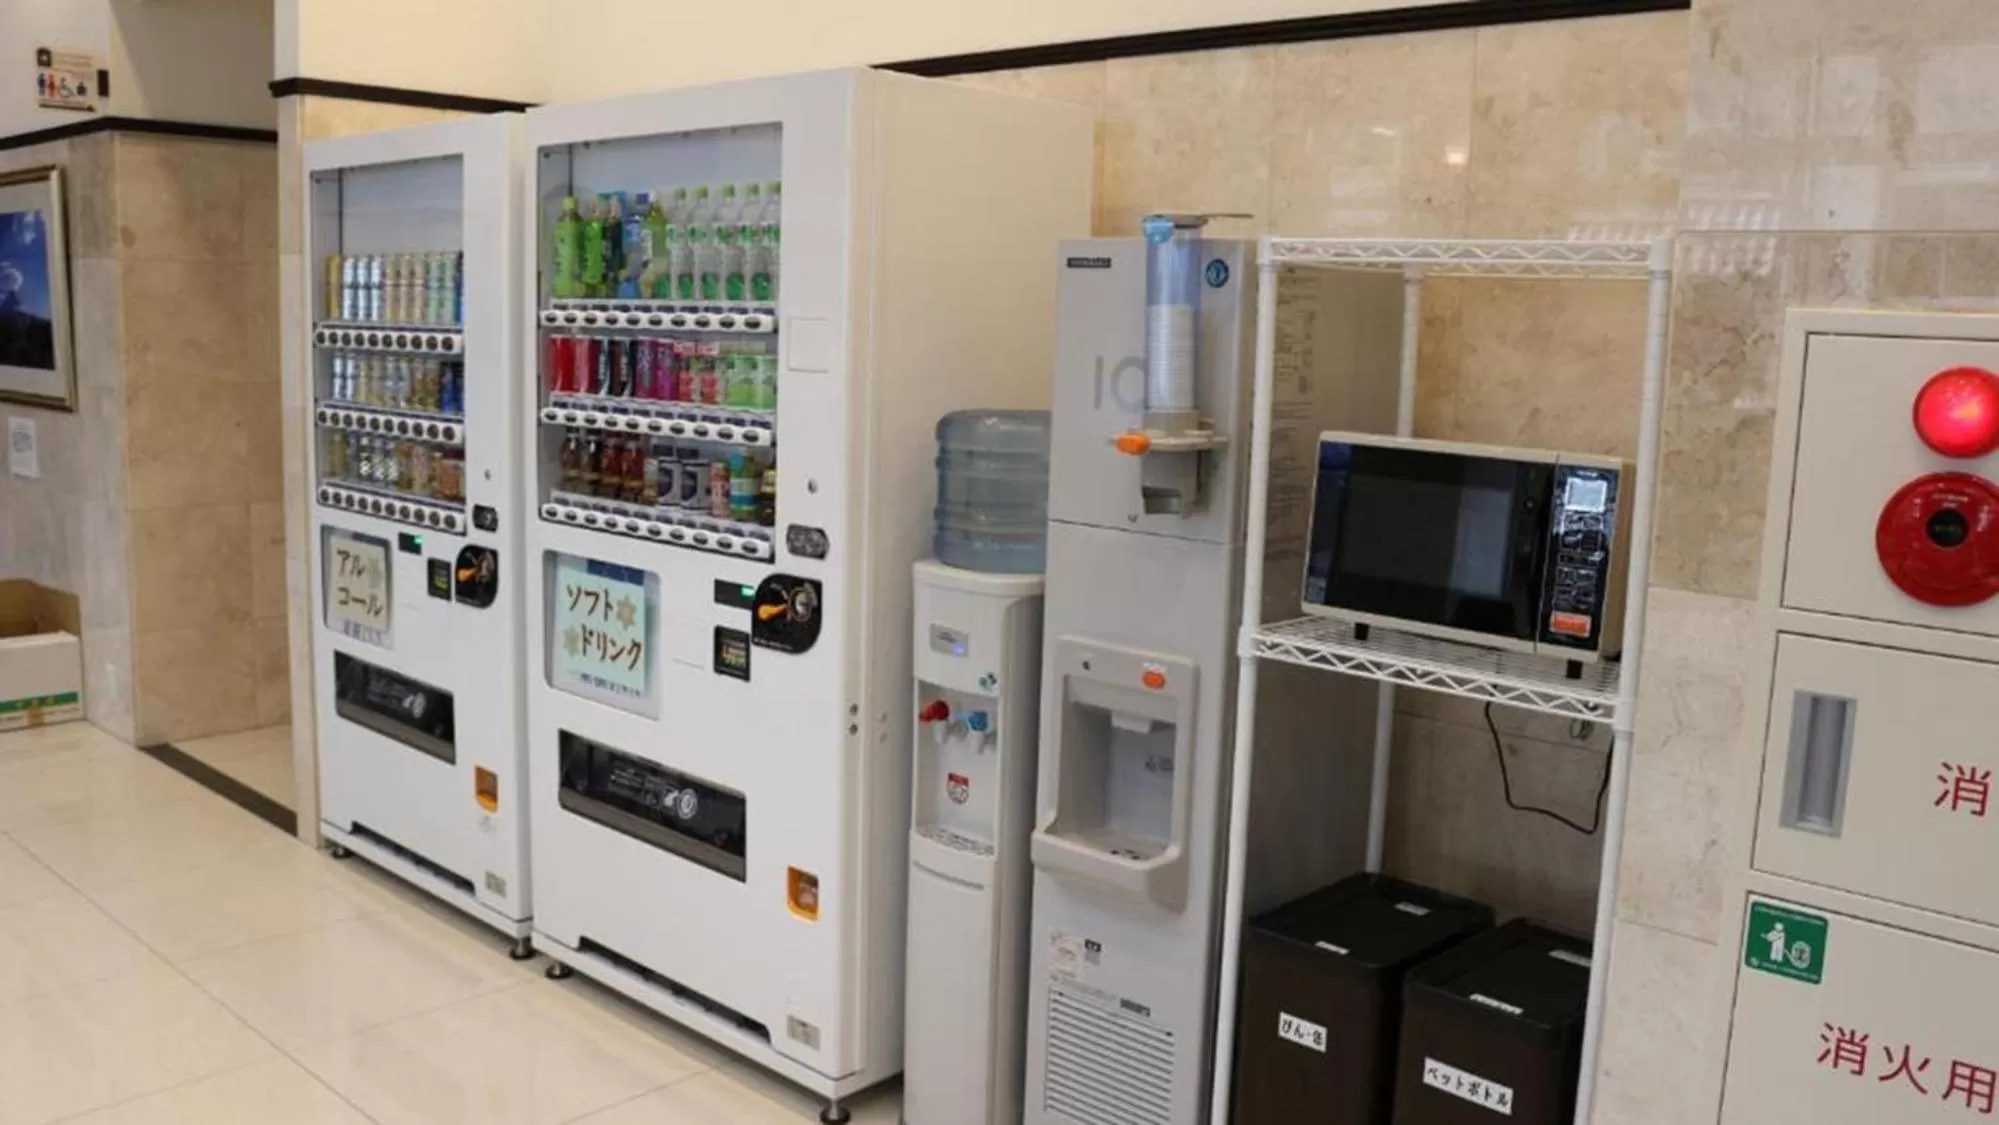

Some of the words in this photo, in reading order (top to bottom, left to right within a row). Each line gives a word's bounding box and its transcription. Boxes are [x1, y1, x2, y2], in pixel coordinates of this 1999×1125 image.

[336, 549, 367, 578] アル
[337, 586, 384, 617] コール
[566, 583, 615, 621] ソフト
[580, 624, 642, 671] ドリンク
[1933, 761, 1993, 818] 消
[1816, 1021, 1997, 1115] 消火用
